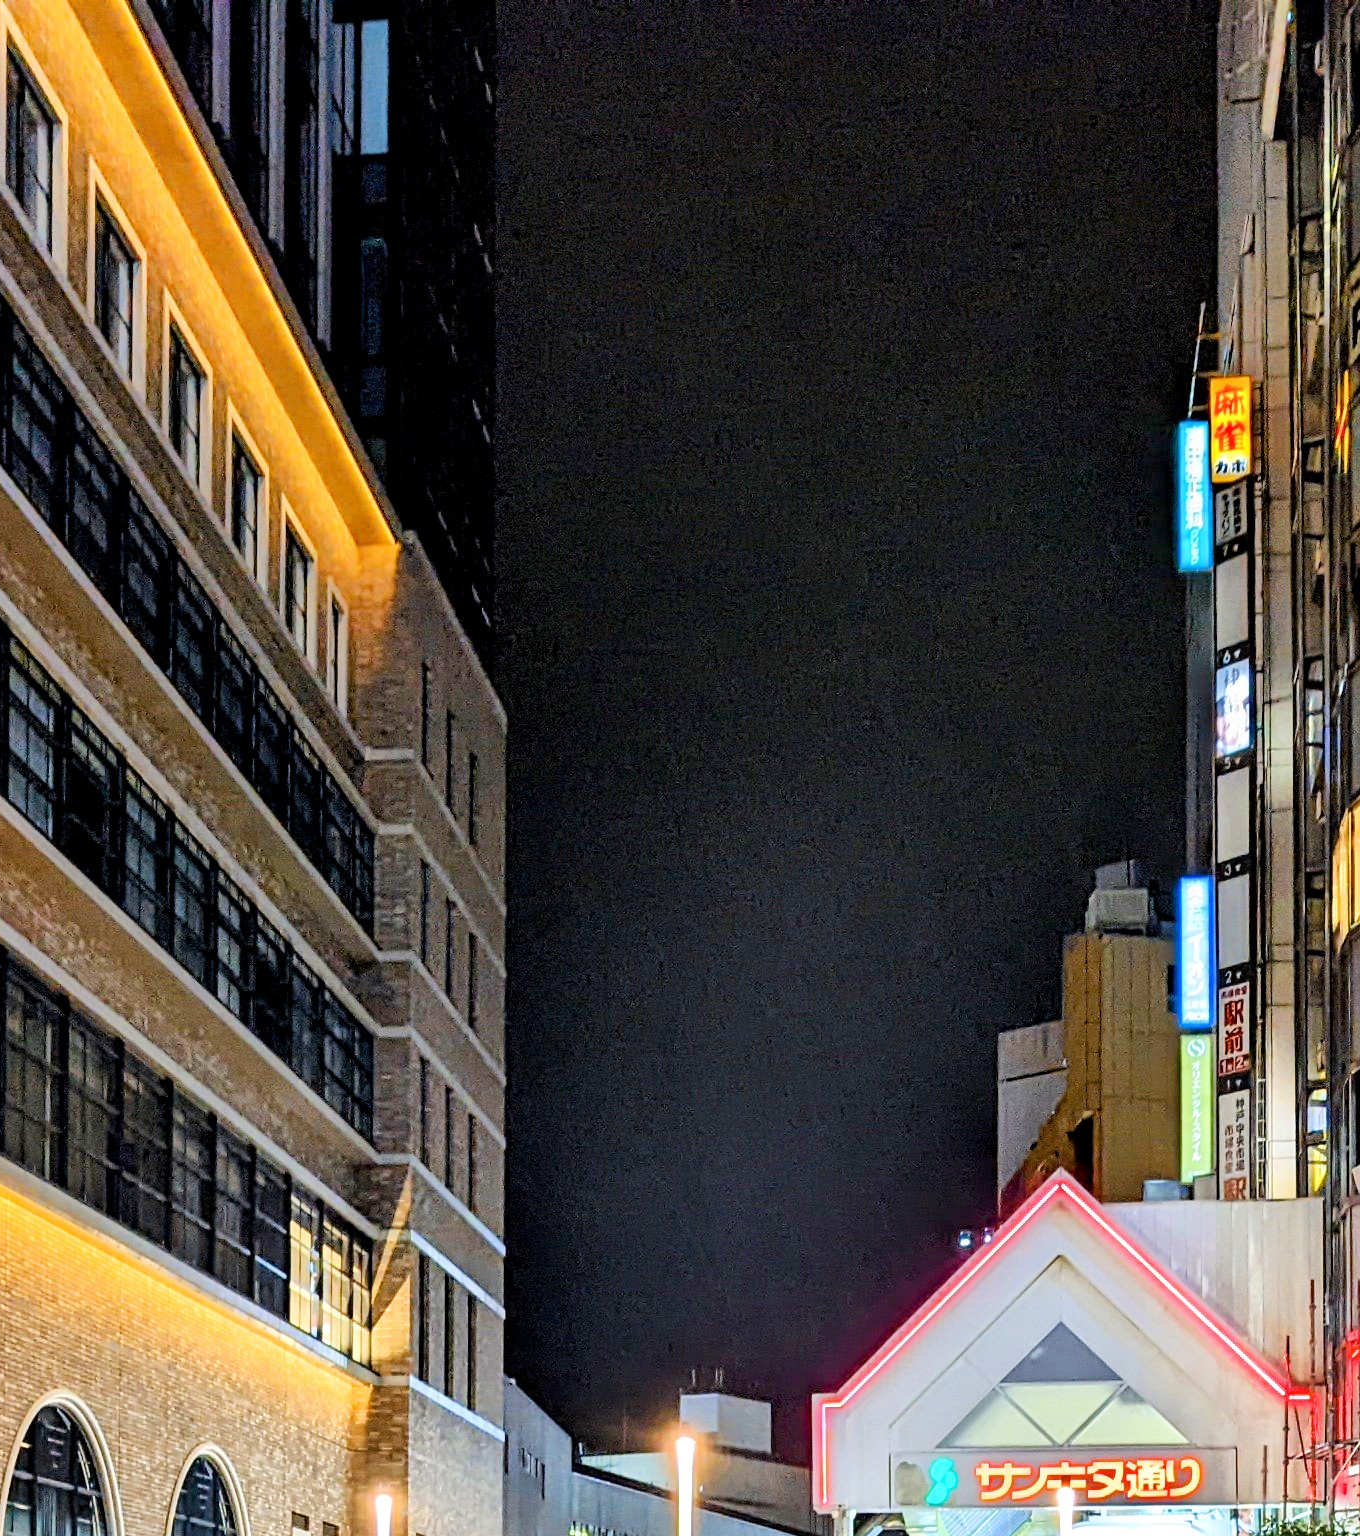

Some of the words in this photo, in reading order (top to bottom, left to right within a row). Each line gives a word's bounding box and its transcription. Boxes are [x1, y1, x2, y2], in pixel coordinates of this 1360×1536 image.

[1214, 384, 1245, 452] 麻雀
[1224, 999, 1244, 1055] 駅前
[975, 1458, 1202, 1500] サンキタ通り
